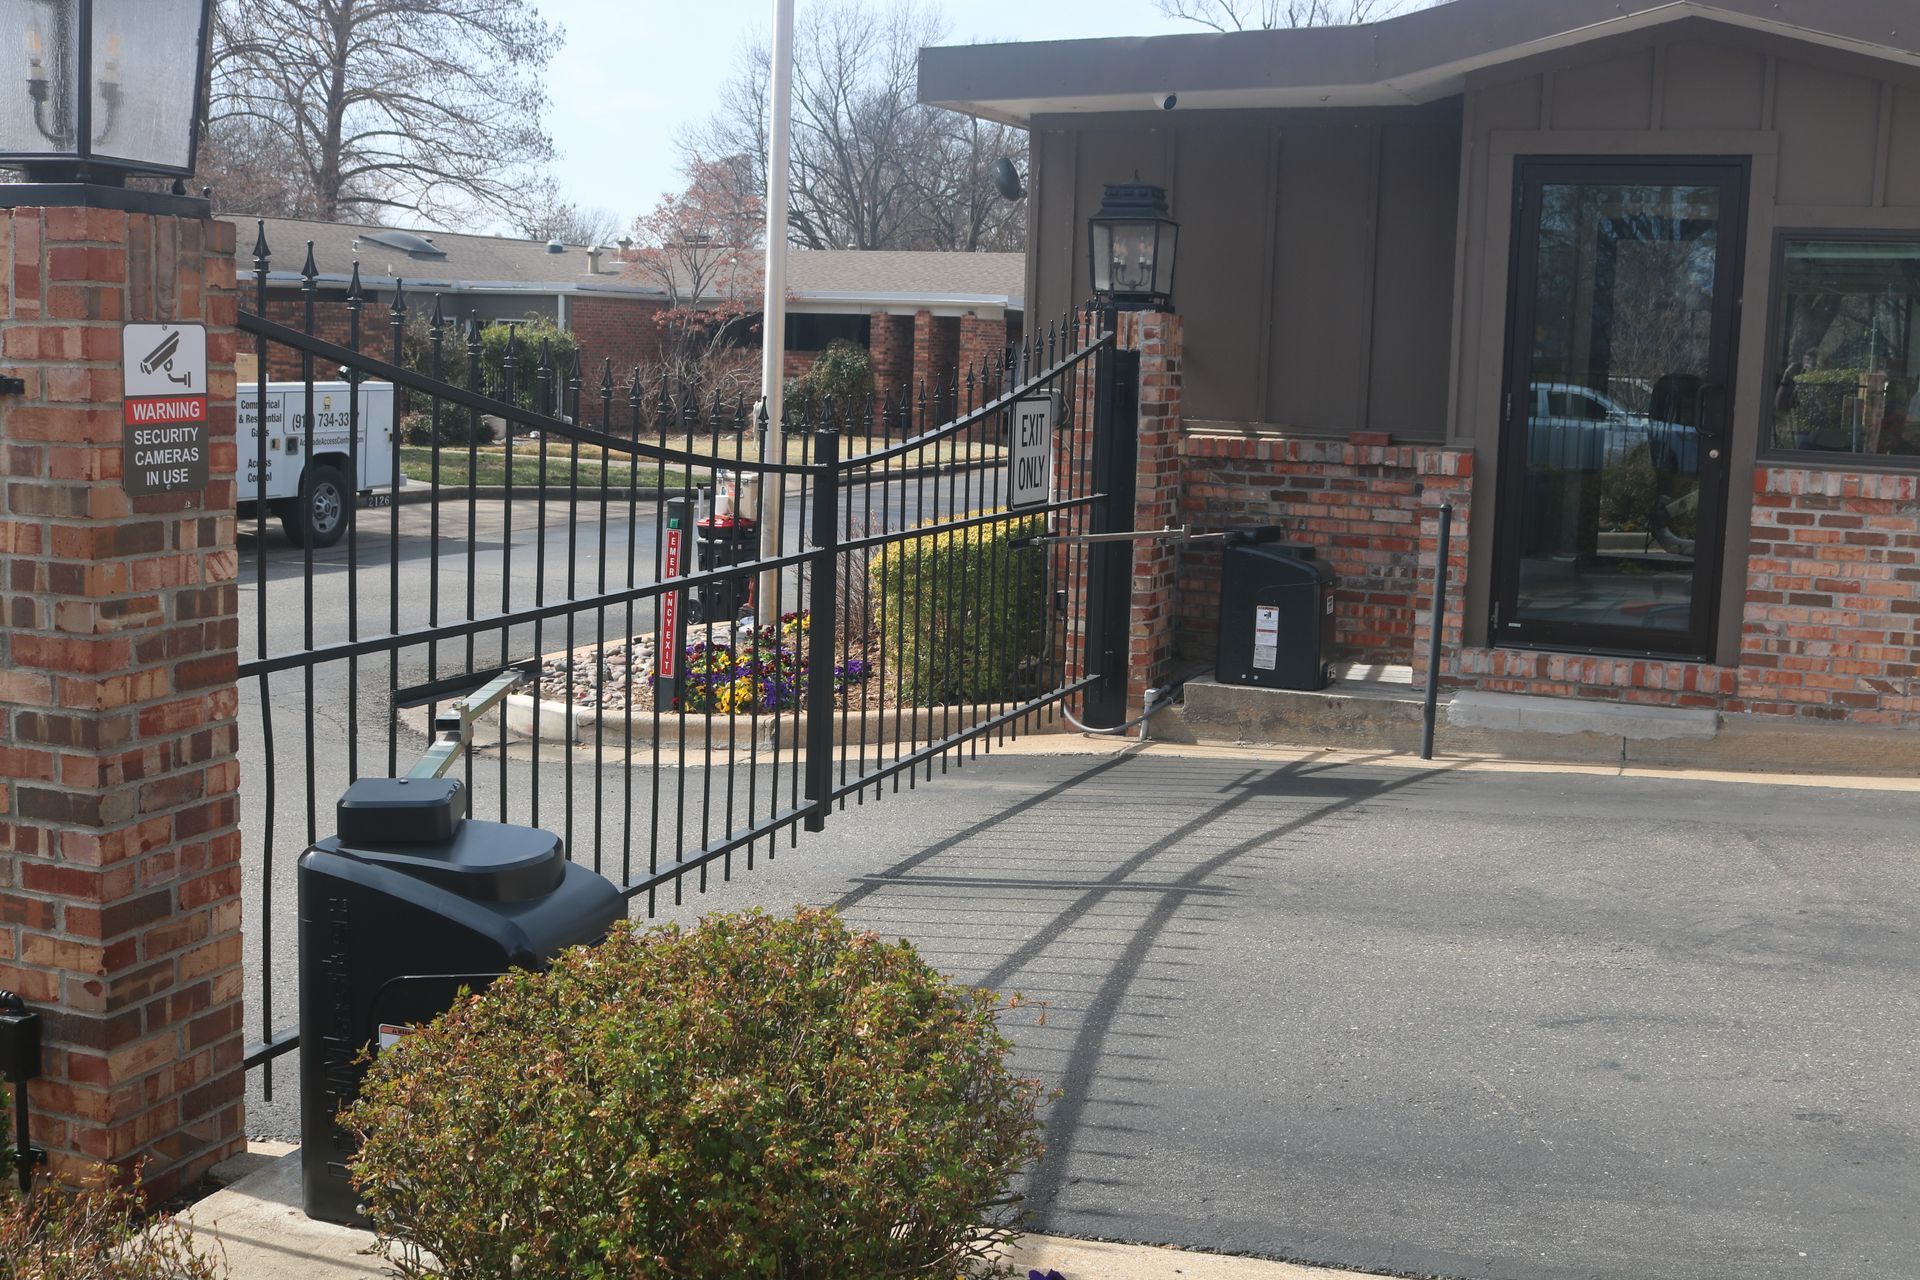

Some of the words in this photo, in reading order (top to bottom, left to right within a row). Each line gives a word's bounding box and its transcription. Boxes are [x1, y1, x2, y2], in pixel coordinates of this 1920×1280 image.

[132, 401, 200, 420] WARNING
[134, 427, 199, 445] SECURITY
[1021, 414, 1045, 447] EXIT
[135, 447, 199, 466] CAMERAS
[146, 470, 159, 486] IN
[163, 468, 189, 484] USE
[1018, 455, 1046, 491] ONLY
[666, 537, 676, 627] EMERENCY
